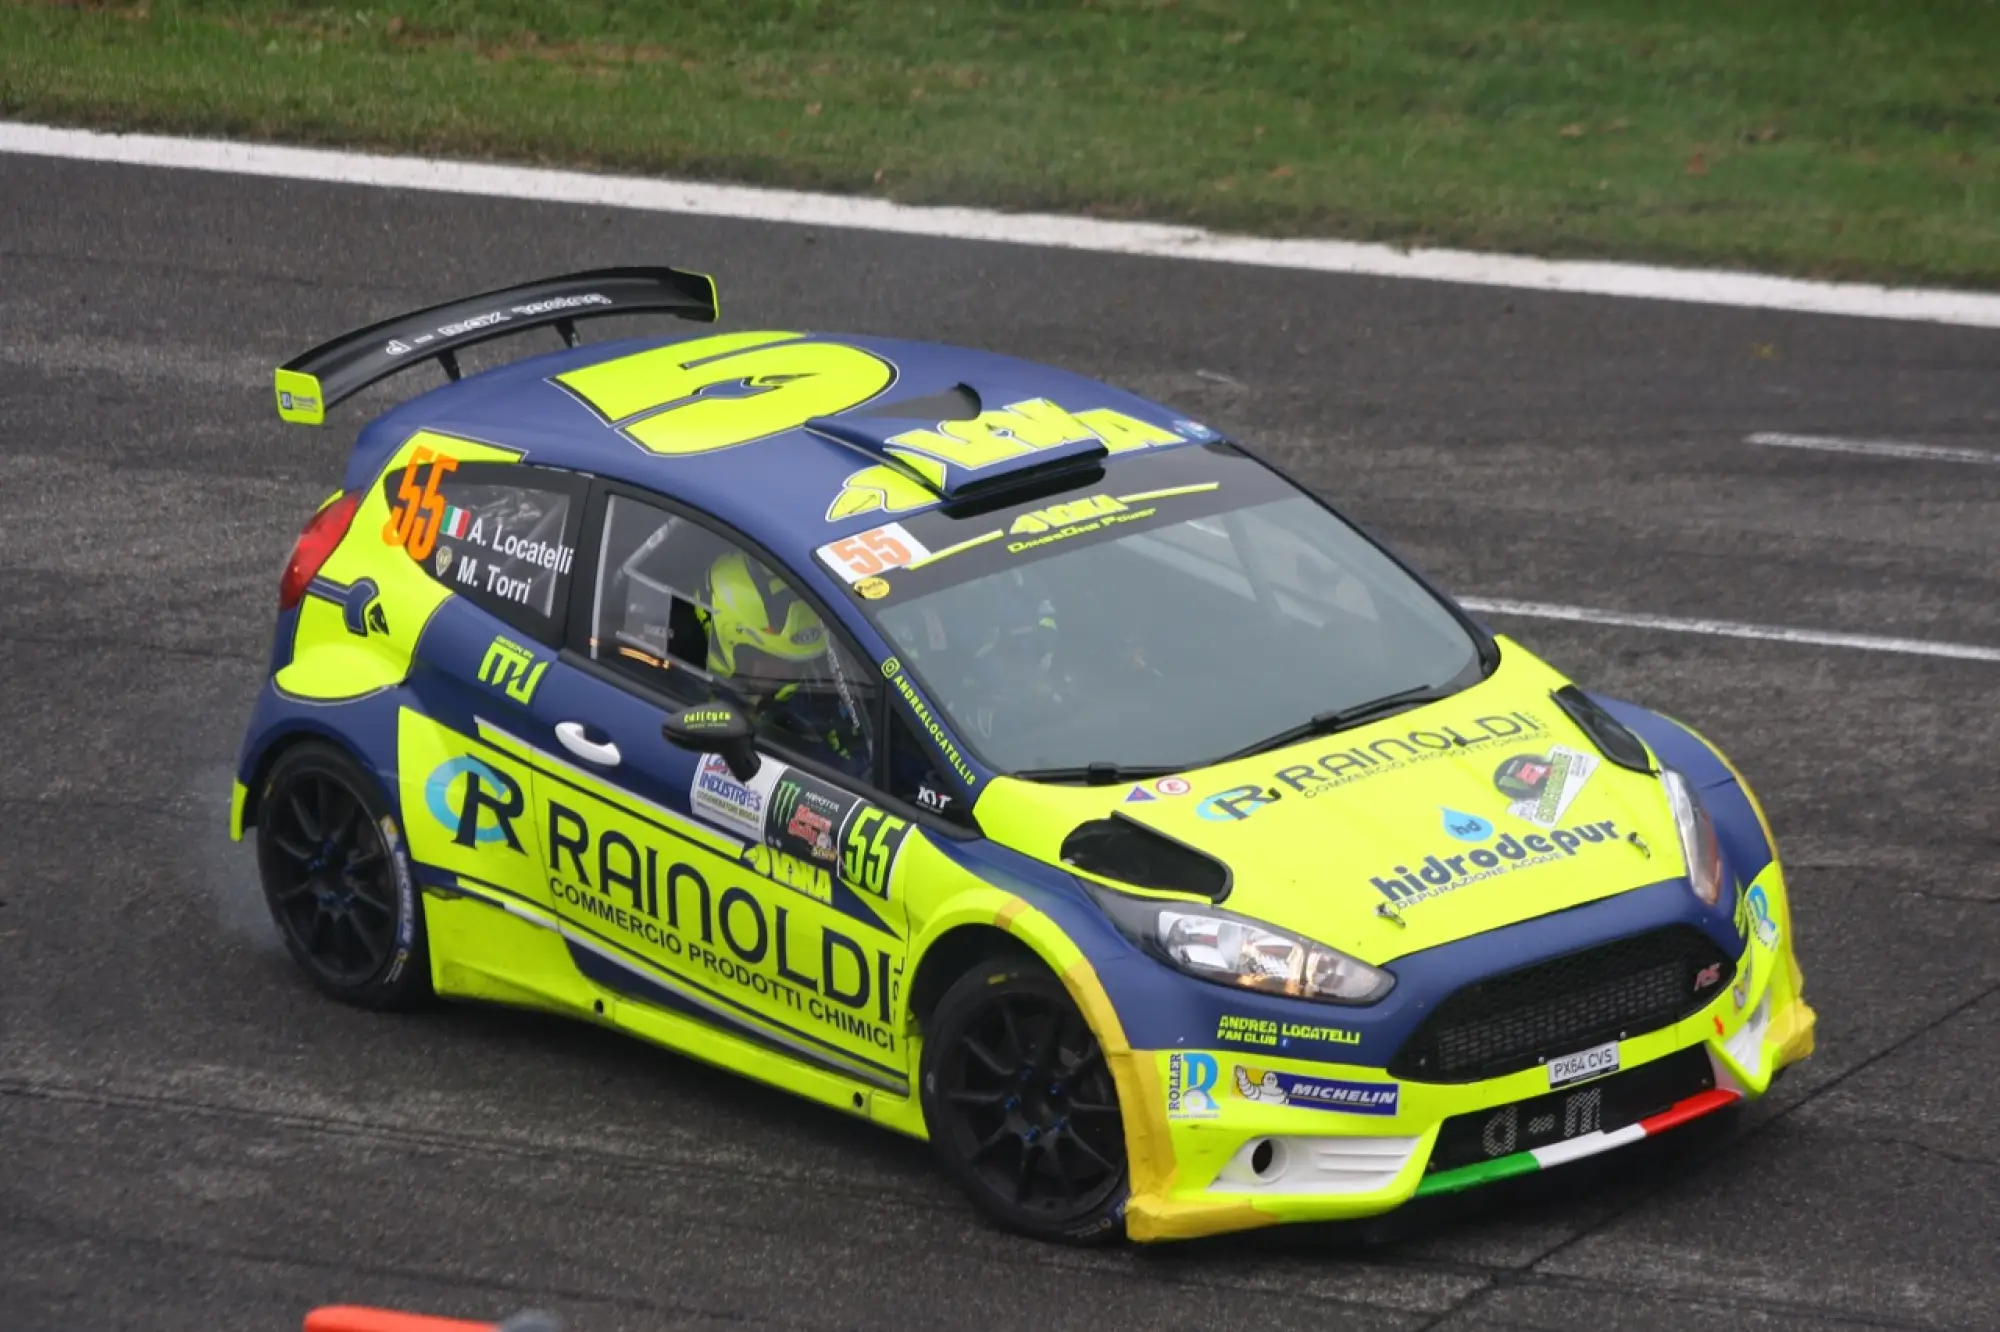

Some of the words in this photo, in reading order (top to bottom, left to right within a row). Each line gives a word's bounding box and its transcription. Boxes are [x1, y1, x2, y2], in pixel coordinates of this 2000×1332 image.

[381, 446, 459, 562] 55
[467, 524, 487, 547] A.
[493, 523, 574, 576] Locatelli
[829, 528, 912, 575] 55
[457, 556, 479, 588] M.
[487, 564, 532, 605] Torri
[1273, 711, 1540, 793] RAINOLDI
[1304, 759, 1405, 798] COMMERCIO
[845, 806, 907, 895] 55
[1450, 819, 1483, 836] hd
[1369, 819, 1620, 902] hidrodepur
[1395, 866, 1507, 910] DEPURAZIONE
[1511, 851, 1566, 872] ACQUE
[548, 799, 893, 1025] RAINOLDI
[549, 877, 682, 955] COMMERCIO
[688, 943, 803, 1011] PRODOTTI
[808, 996, 896, 1053] CHIMICI
[1216, 1028, 1242, 1043] FAN
[1244, 1031, 1278, 1046] CLUB
[1219, 1014, 1278, 1036] ANDREA
[1282, 1022, 1362, 1045] LOCATELLI
[1169, 1053, 1181, 1112] ROLLER
[1553, 1056, 1586, 1078] PX64
[1588, 1048, 1613, 1068] CVS
[1291, 1083, 1397, 1106] MICHELIN
